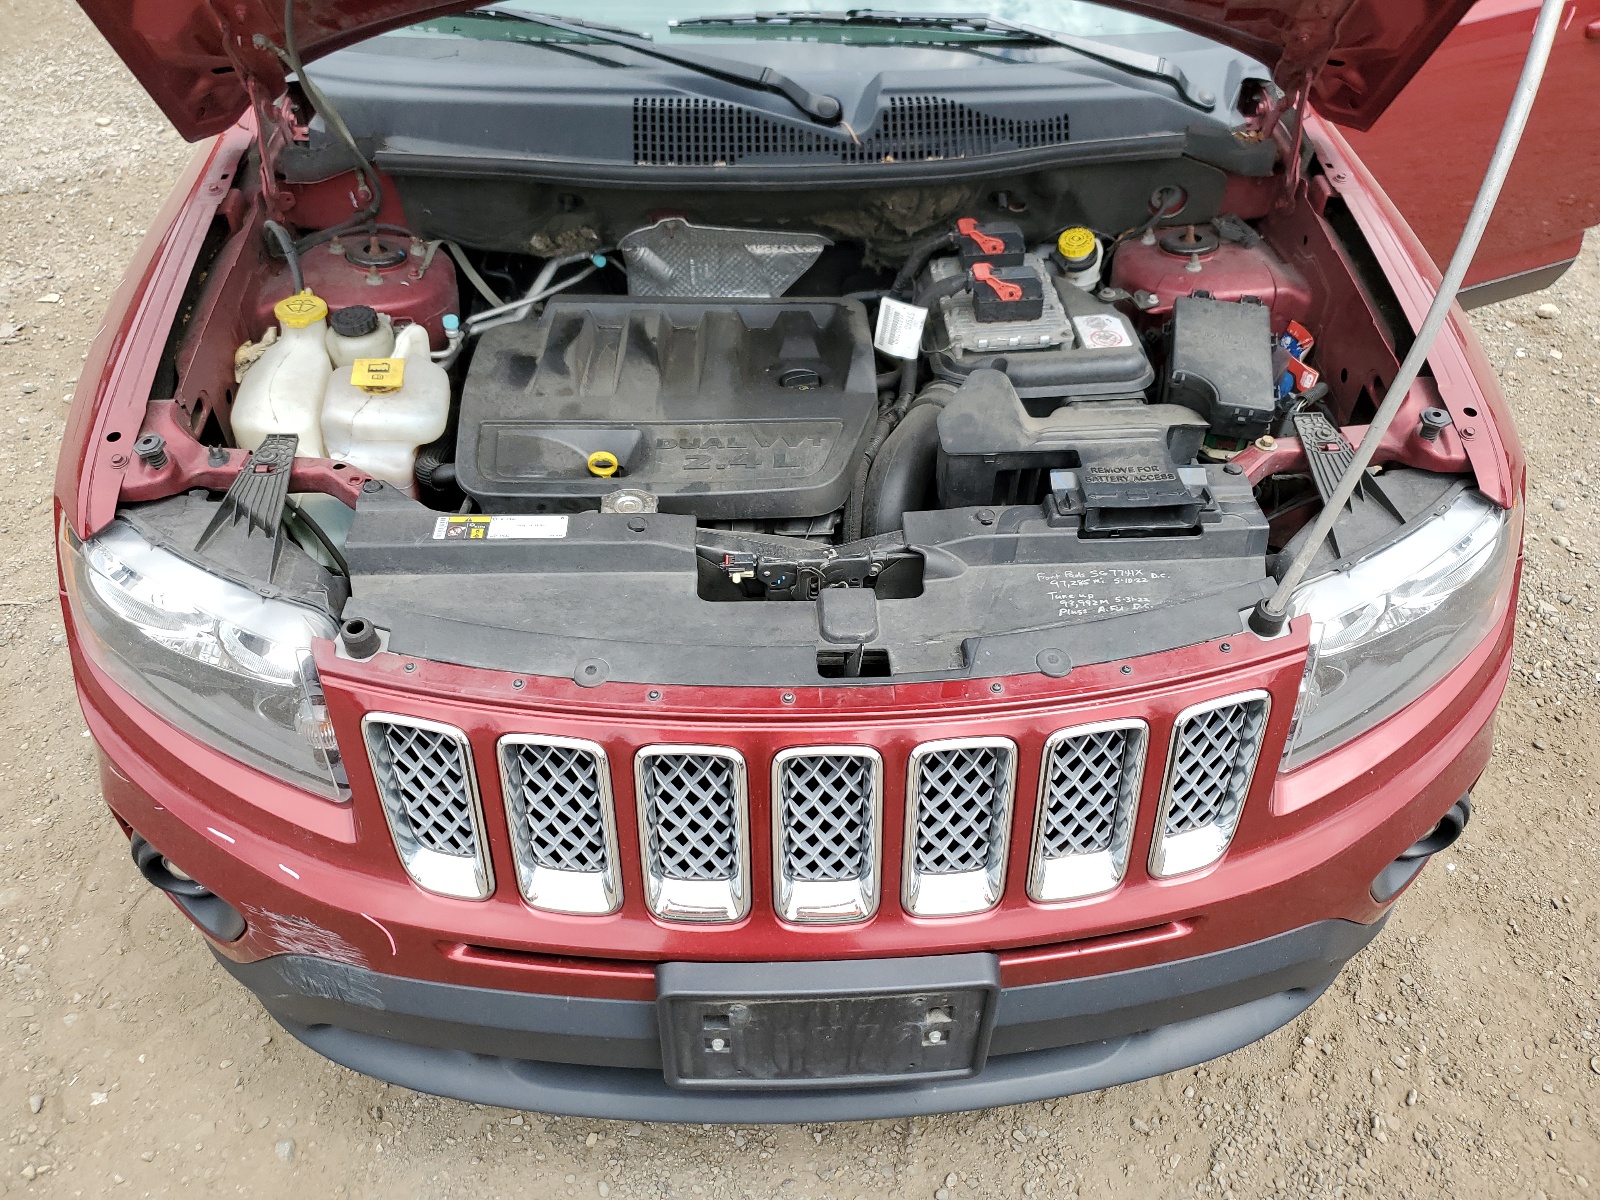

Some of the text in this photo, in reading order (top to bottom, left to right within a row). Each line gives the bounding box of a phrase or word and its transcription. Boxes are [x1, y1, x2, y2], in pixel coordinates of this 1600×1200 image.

[656, 437, 748, 450] DUAL
[1090, 465, 1160, 475] REMOVE FOR
[1084, 473, 1177, 483] BATTERY ACCESS
[1036, 572, 1061, 582] Front
[1046, 591, 1076, 600] Tune
